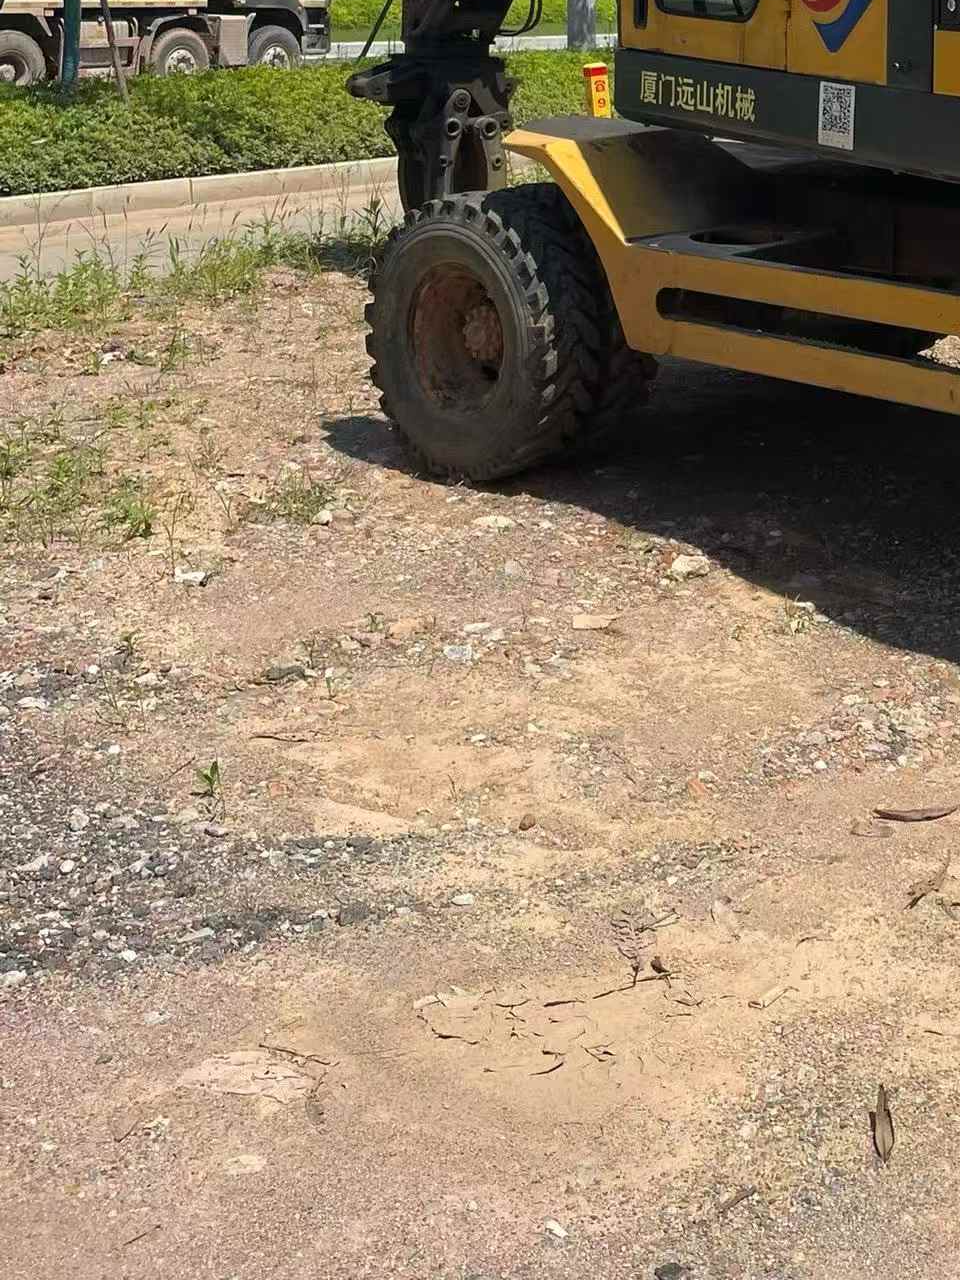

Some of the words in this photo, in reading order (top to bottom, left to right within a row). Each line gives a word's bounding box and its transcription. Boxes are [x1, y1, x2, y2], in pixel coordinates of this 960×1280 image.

[640, 70, 756, 122] 厦门远山机械
